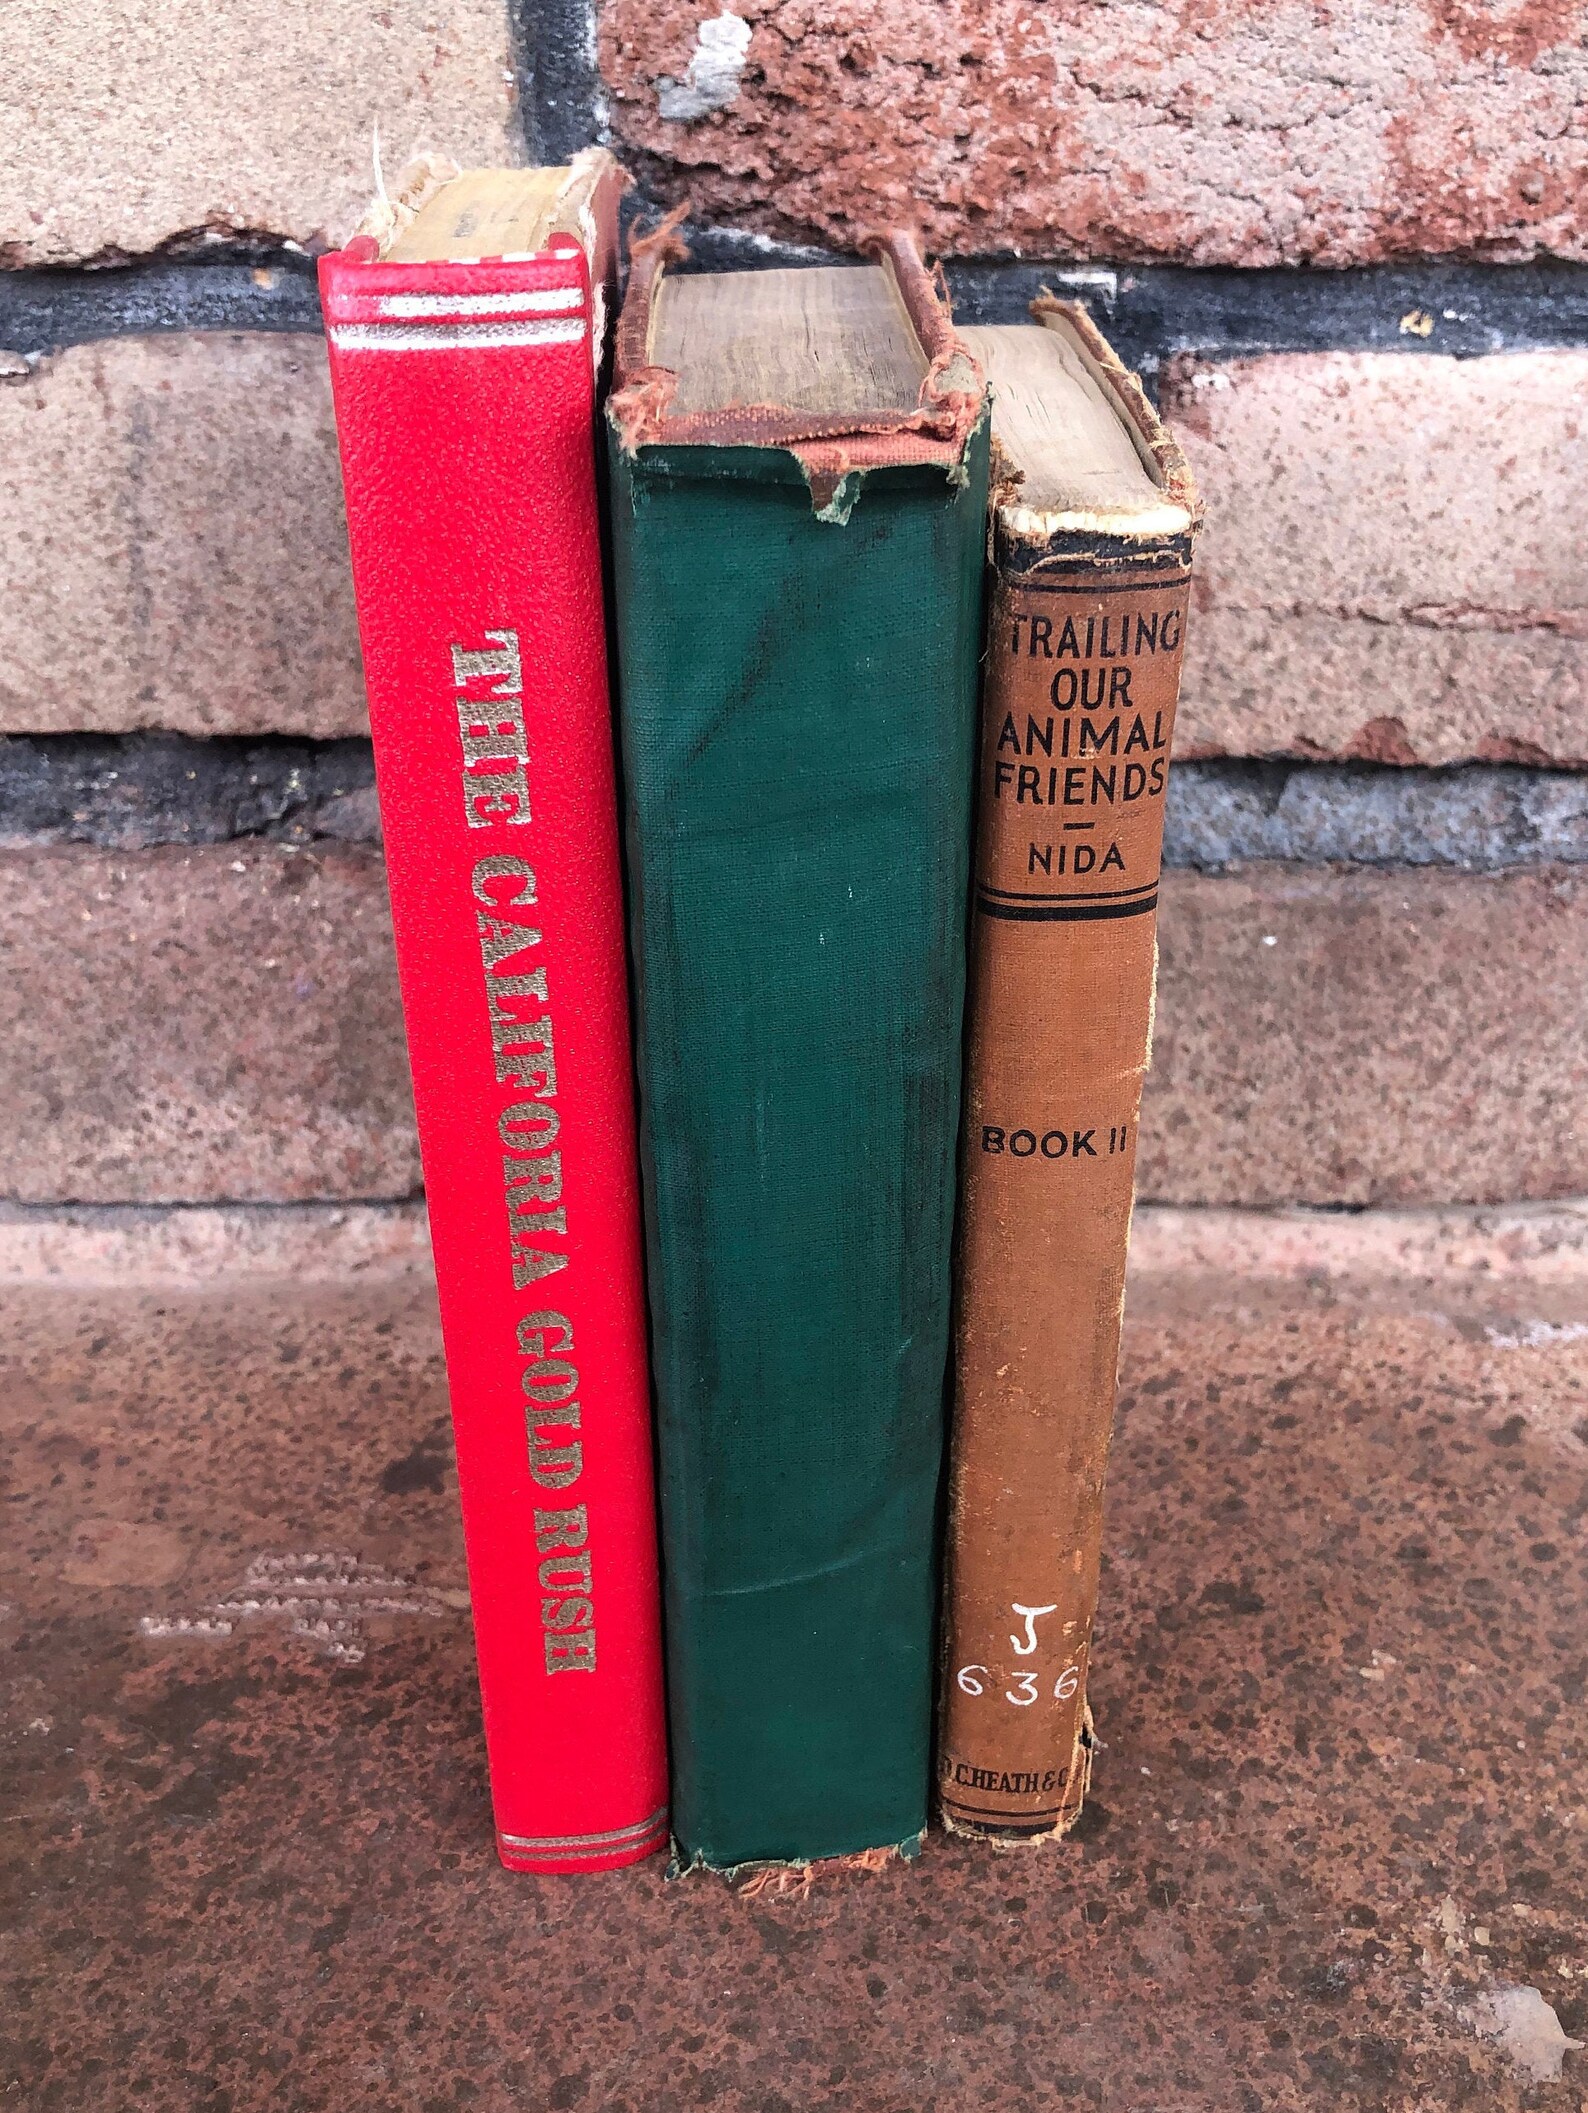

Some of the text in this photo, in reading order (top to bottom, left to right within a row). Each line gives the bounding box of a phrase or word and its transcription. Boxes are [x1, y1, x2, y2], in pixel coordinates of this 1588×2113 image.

[1008, 610, 1181, 659] TRAILING
[1050, 667, 1133, 711] OUR
[997, 710, 1168, 758] ANIMAL
[994, 756, 1165, 806] FRIENDS
[1028, 842, 1127, 876] NIDA
[451, 627, 597, 1677] THE CALIFORIA GOLD RUSH
[981, 1125, 1127, 1159] BOOK II
[1009, 1602, 1058, 1655] J
